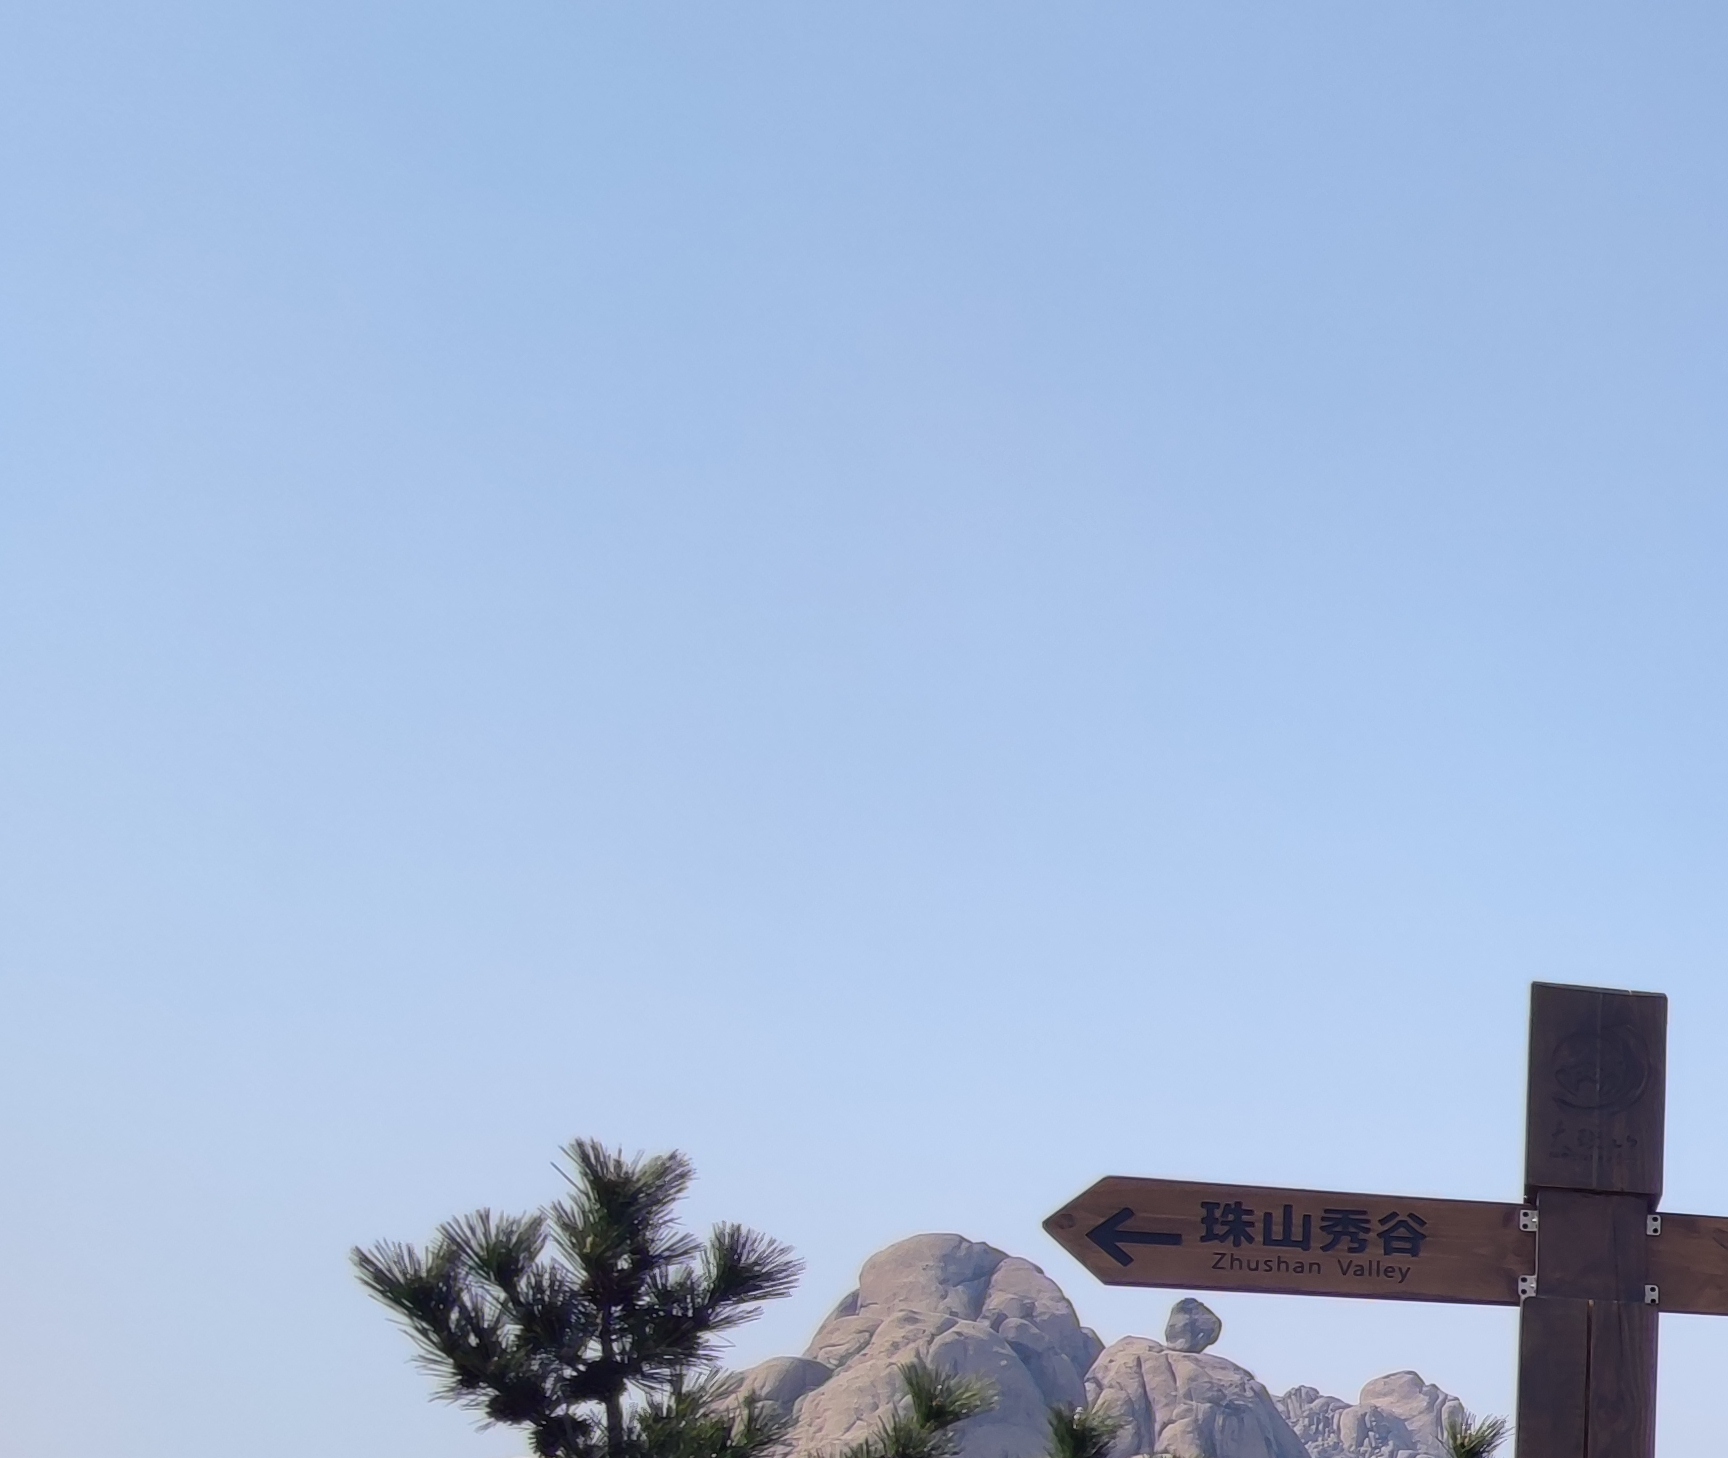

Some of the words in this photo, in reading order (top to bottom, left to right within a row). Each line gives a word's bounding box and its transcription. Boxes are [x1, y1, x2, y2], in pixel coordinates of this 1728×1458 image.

[1200, 1201, 1428, 1257] 珠山秀谷
[1212, 1252, 1322, 1275] Zhushan
[1337, 1258, 1412, 1284] Valley
